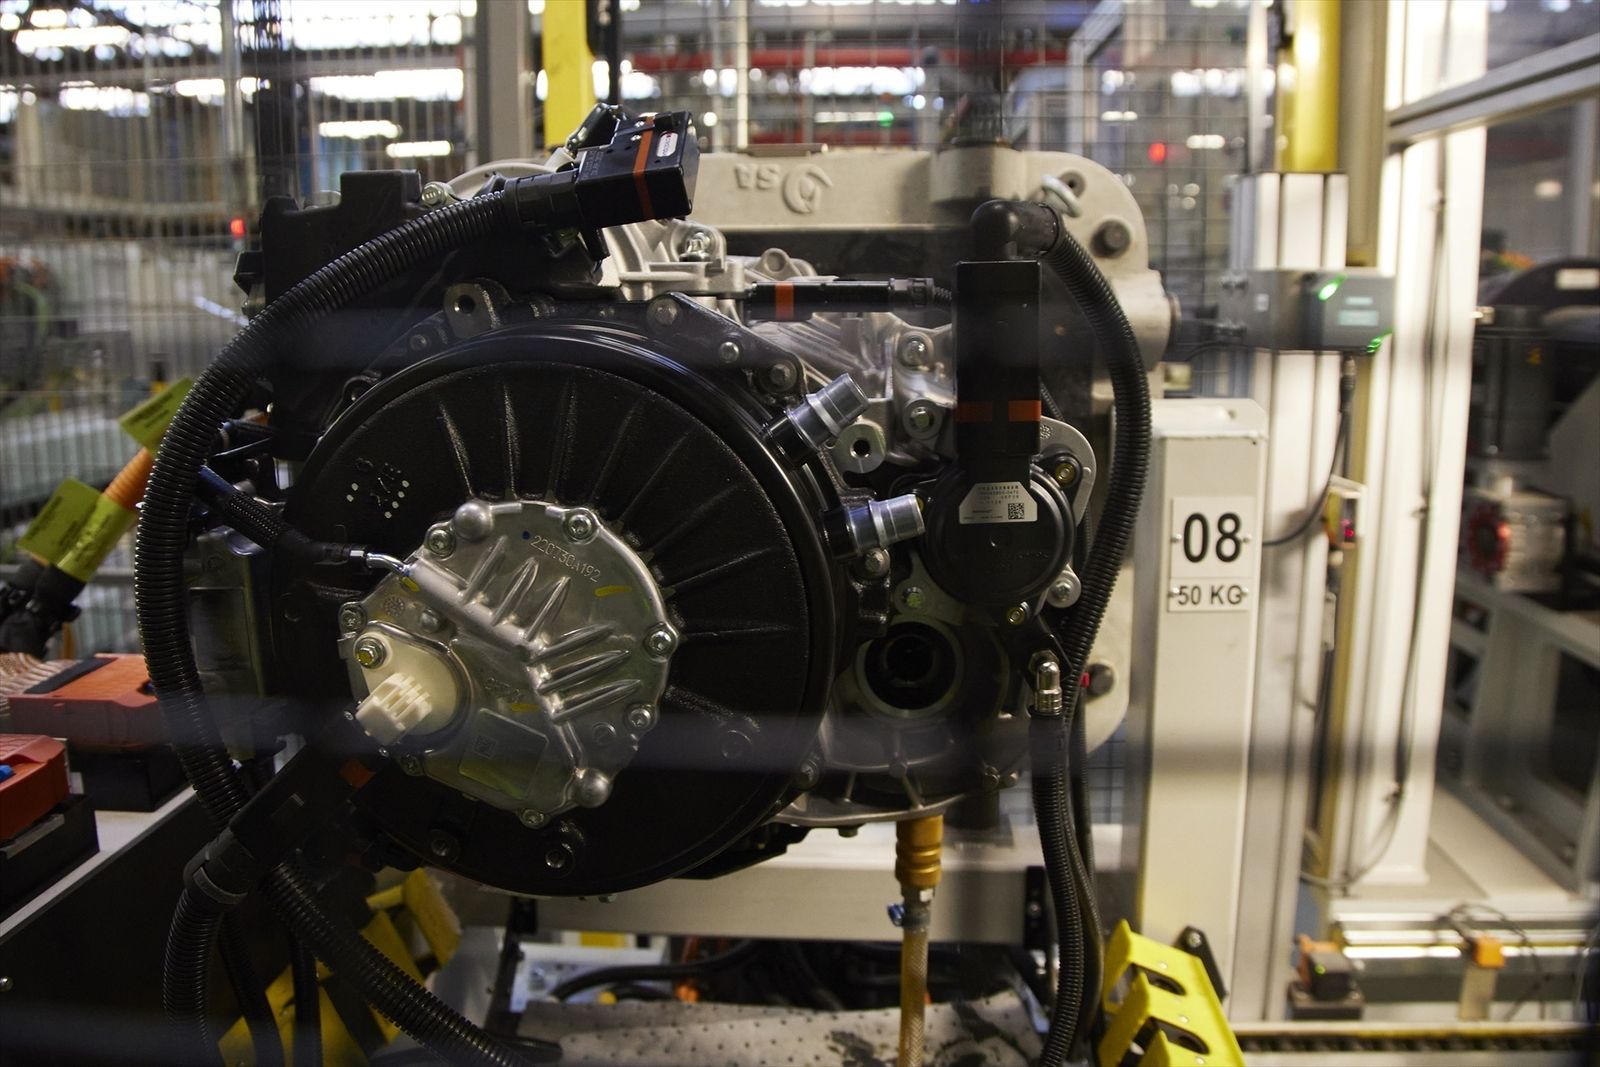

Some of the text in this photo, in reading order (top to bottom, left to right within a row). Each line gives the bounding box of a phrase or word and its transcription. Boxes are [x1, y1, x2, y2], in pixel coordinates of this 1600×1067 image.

[1183, 512, 1242, 563] 08
[1177, 584, 1243, 606] 50 KG
